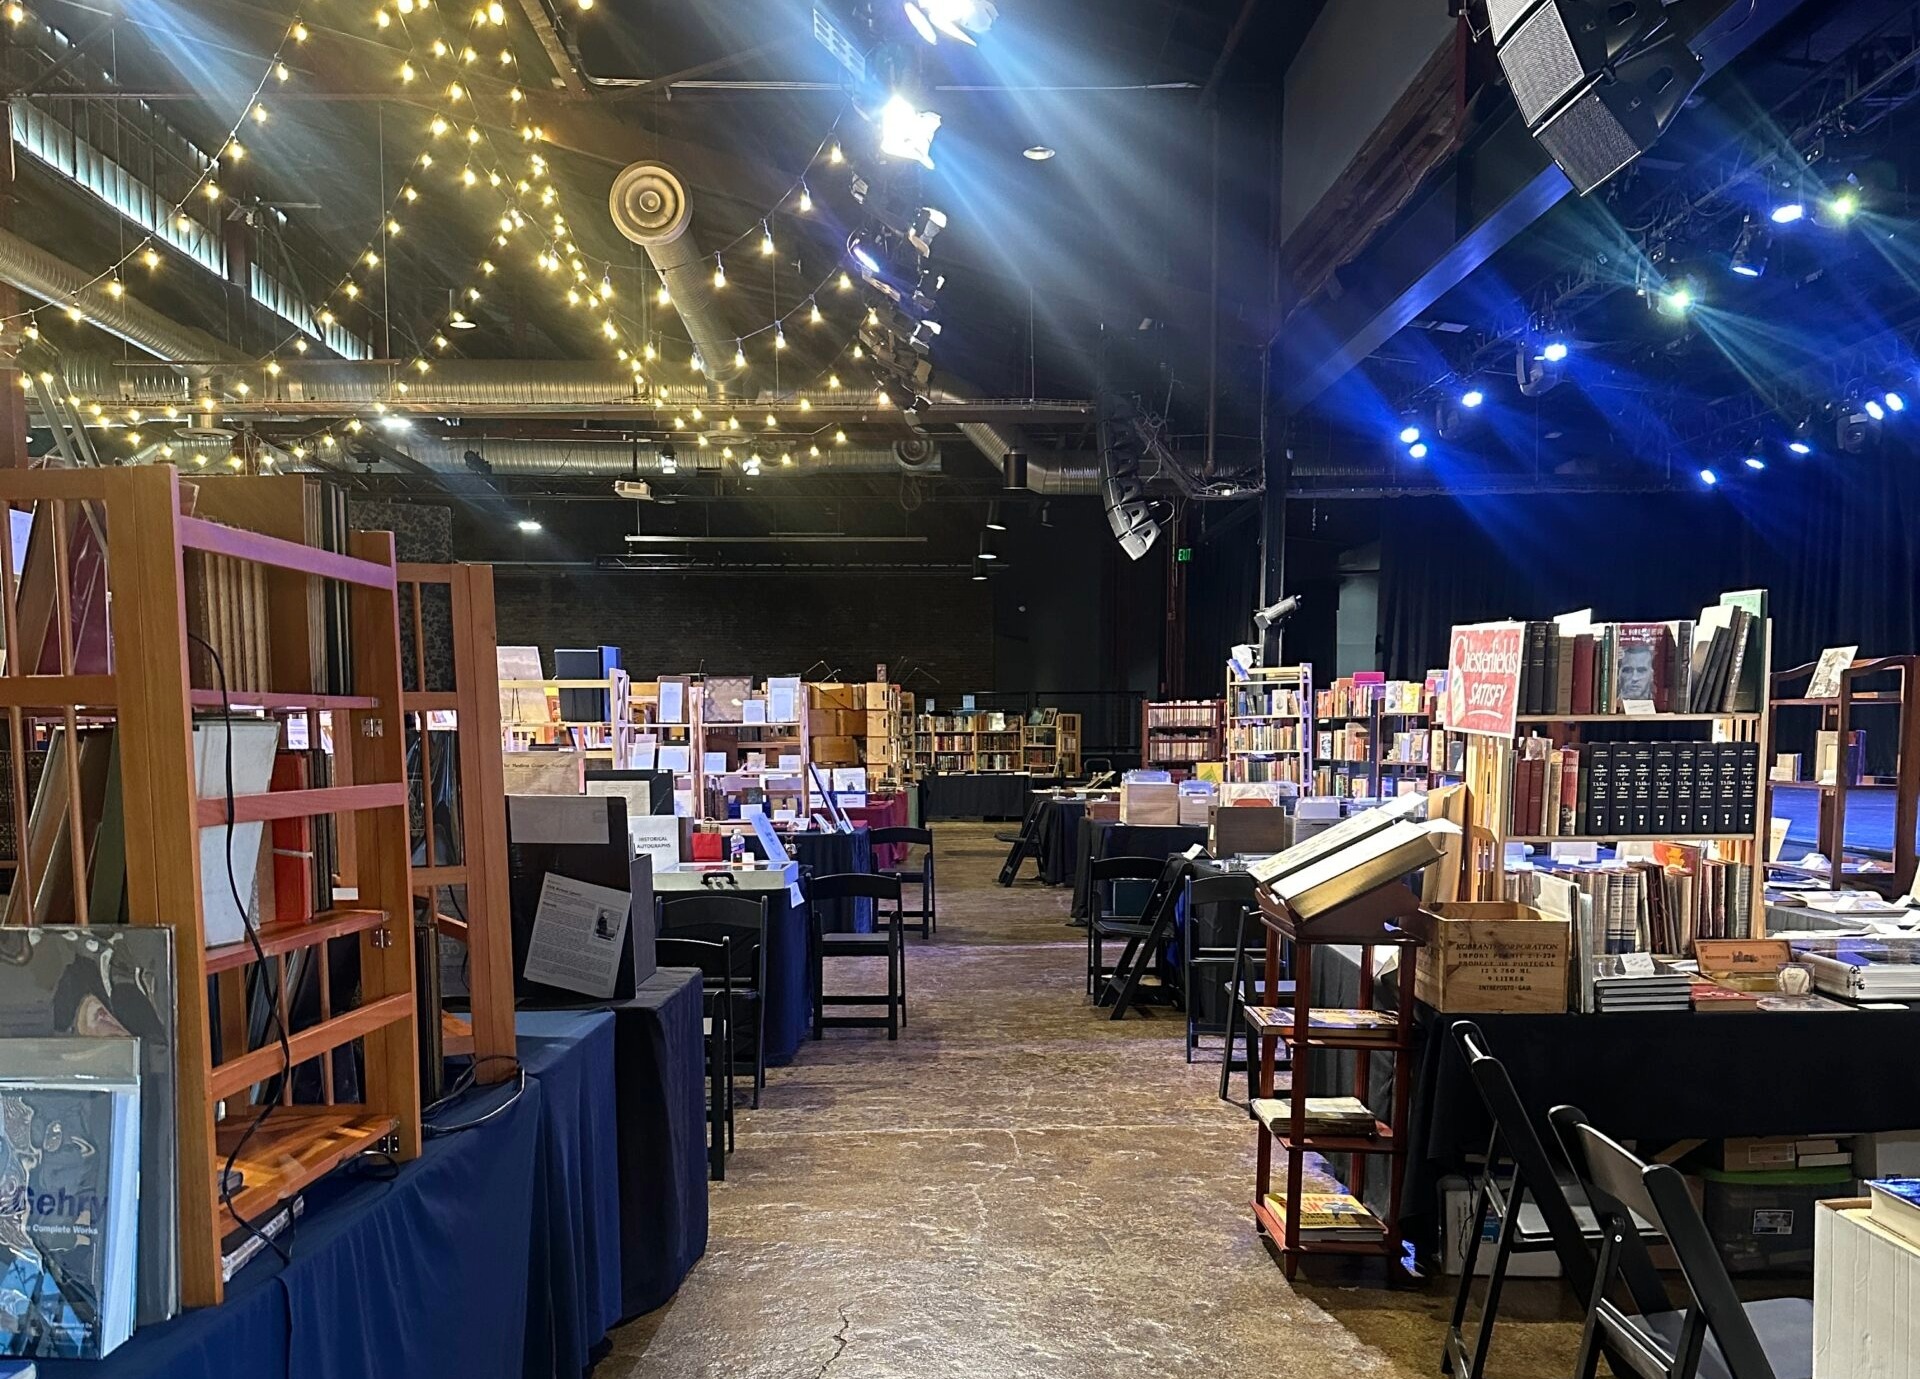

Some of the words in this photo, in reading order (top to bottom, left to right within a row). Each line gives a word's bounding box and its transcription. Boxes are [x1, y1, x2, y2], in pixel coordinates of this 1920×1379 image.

[1178, 548, 1191, 561] EXIT
[1453, 635, 1518, 679] Chesterfields
[1469, 682, 1508, 707] SATISFY
[32, 1223, 71, 1234] Complete
[73, 1225, 99, 1236] Works
